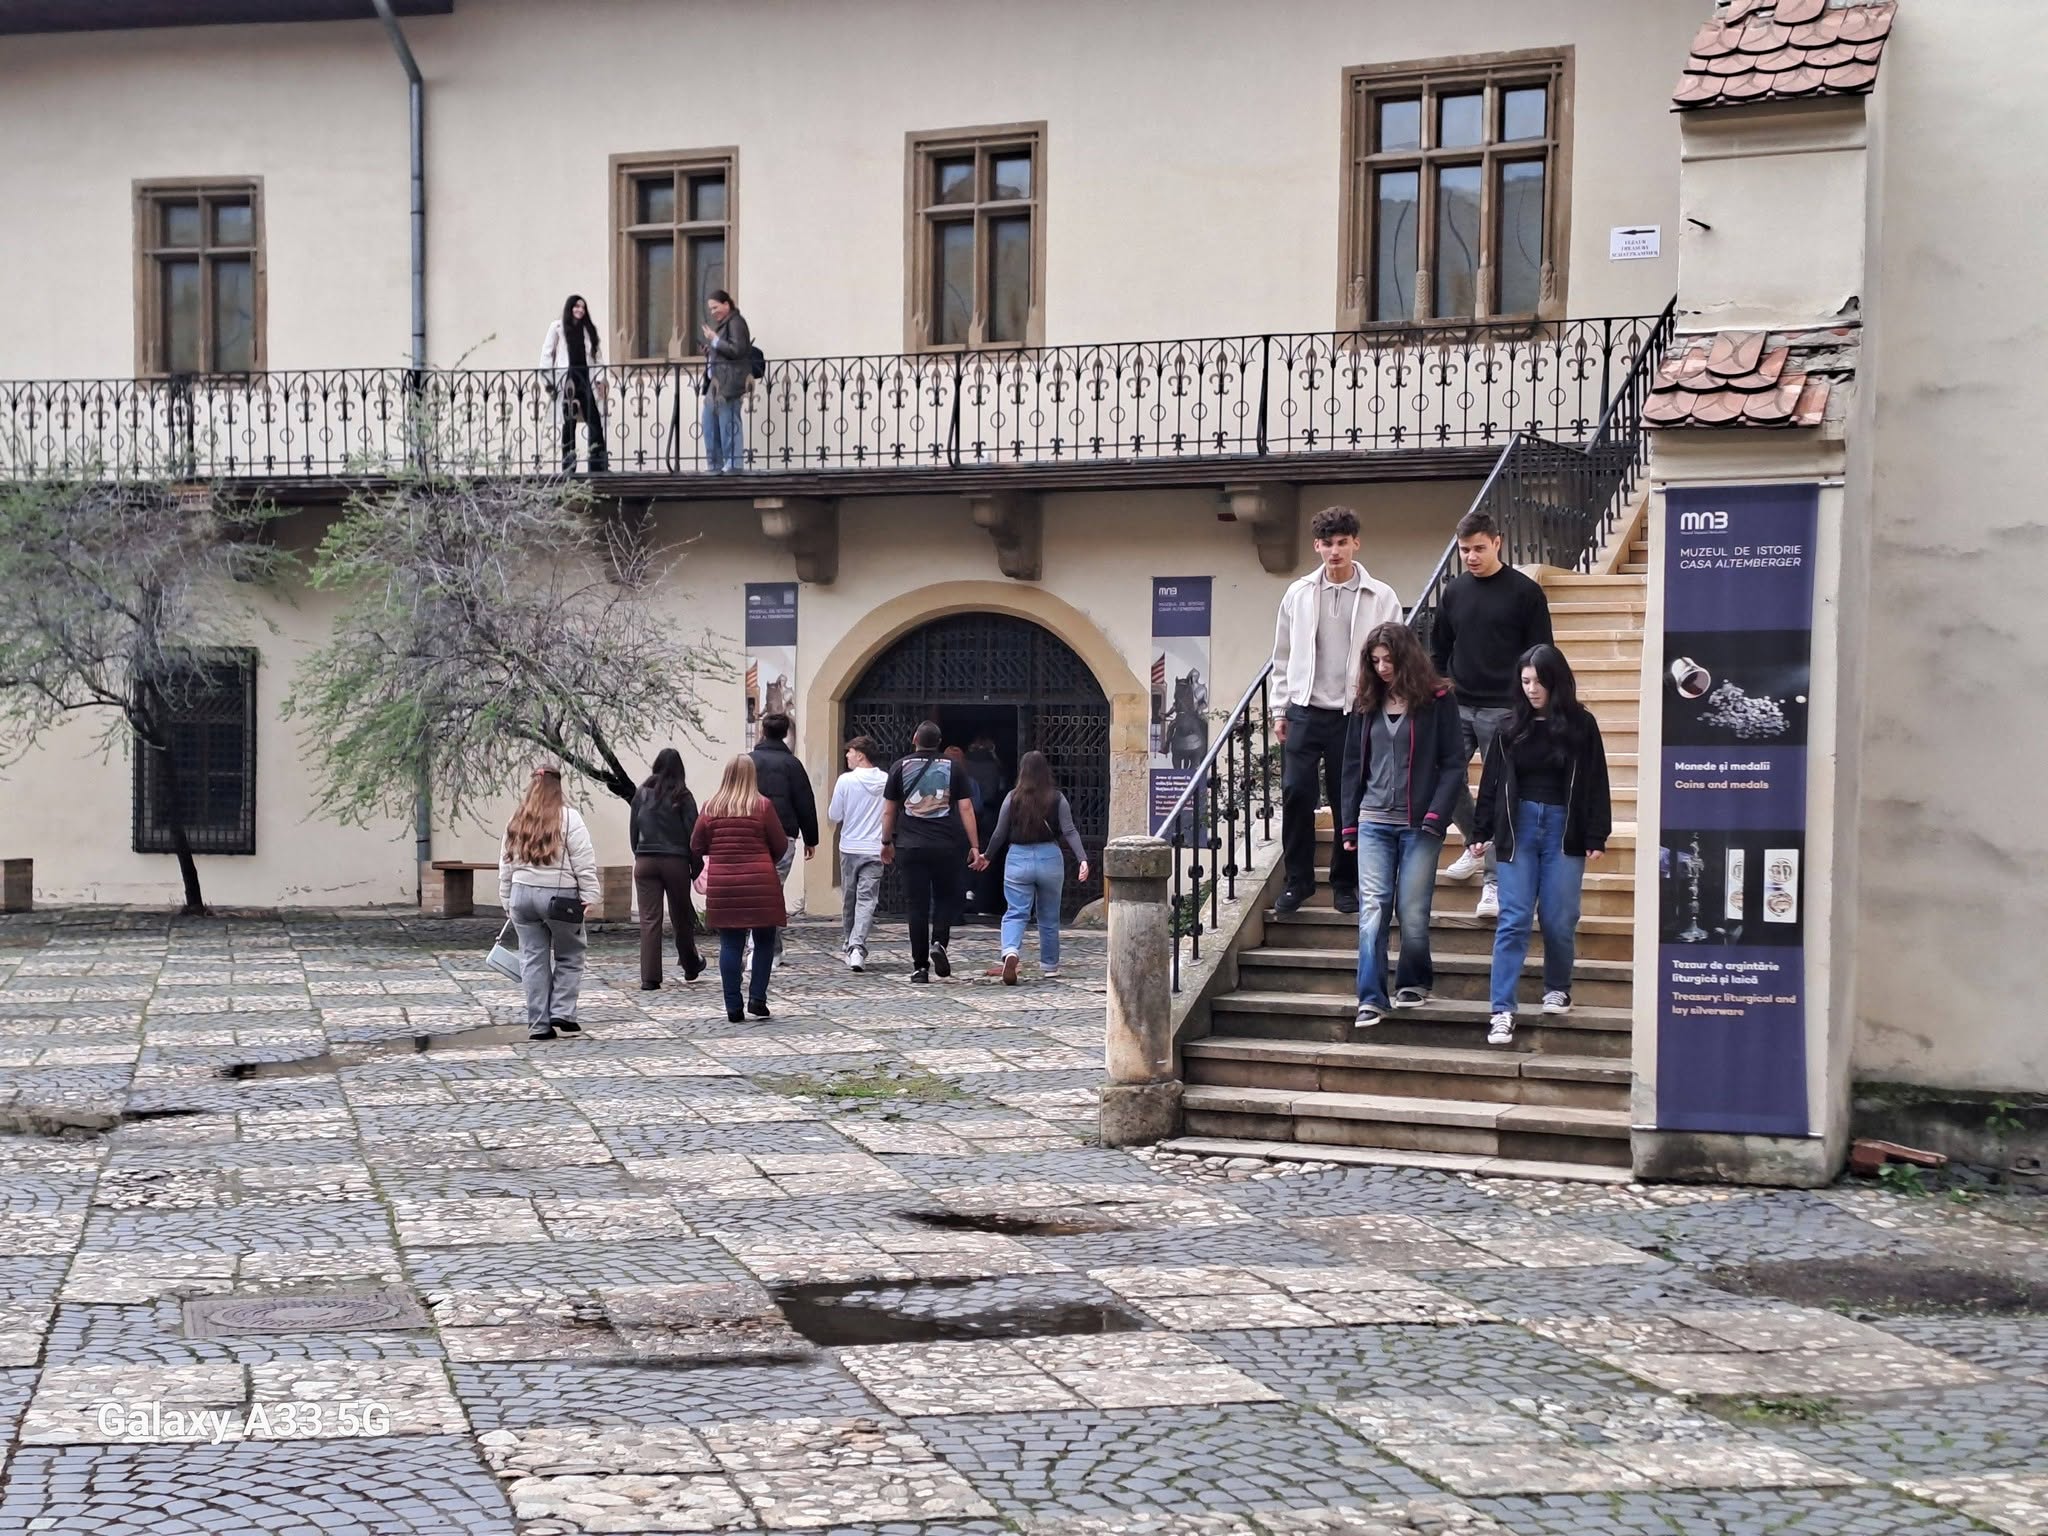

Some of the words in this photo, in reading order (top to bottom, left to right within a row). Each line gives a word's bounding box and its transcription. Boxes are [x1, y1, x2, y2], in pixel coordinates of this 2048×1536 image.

[1680, 547, 1728, 557] MUZEUL
[1734, 546, 1751, 556] DE
[1757, 545, 1802, 555] ISTORIE
[1680, 560, 1712, 569] CASA
[1714, 557, 1801, 569] ALTEMBERGER
[1674, 762, 1717, 771] Monede
[1730, 761, 1771, 771] medalii
[1674, 780, 1705, 789] Coins
[1707, 780, 1728, 789] and
[1730, 780, 1769, 789] medals
[1672, 960, 1708, 970] Tezaur
[1710, 961, 1723, 970] de
[1725, 961, 1780, 972] argintărie
[1672, 973, 1718, 985] liturgică
[1731, 974, 1759, 985] laică
[1672, 992, 1722, 1003] Treasury:
[1724, 993, 1773, 1004] liturgical
[1775, 995, 1797, 1004] and
[1672, 1005, 1689, 1017] lay
[1690, 1005, 1745, 1016] silverware
